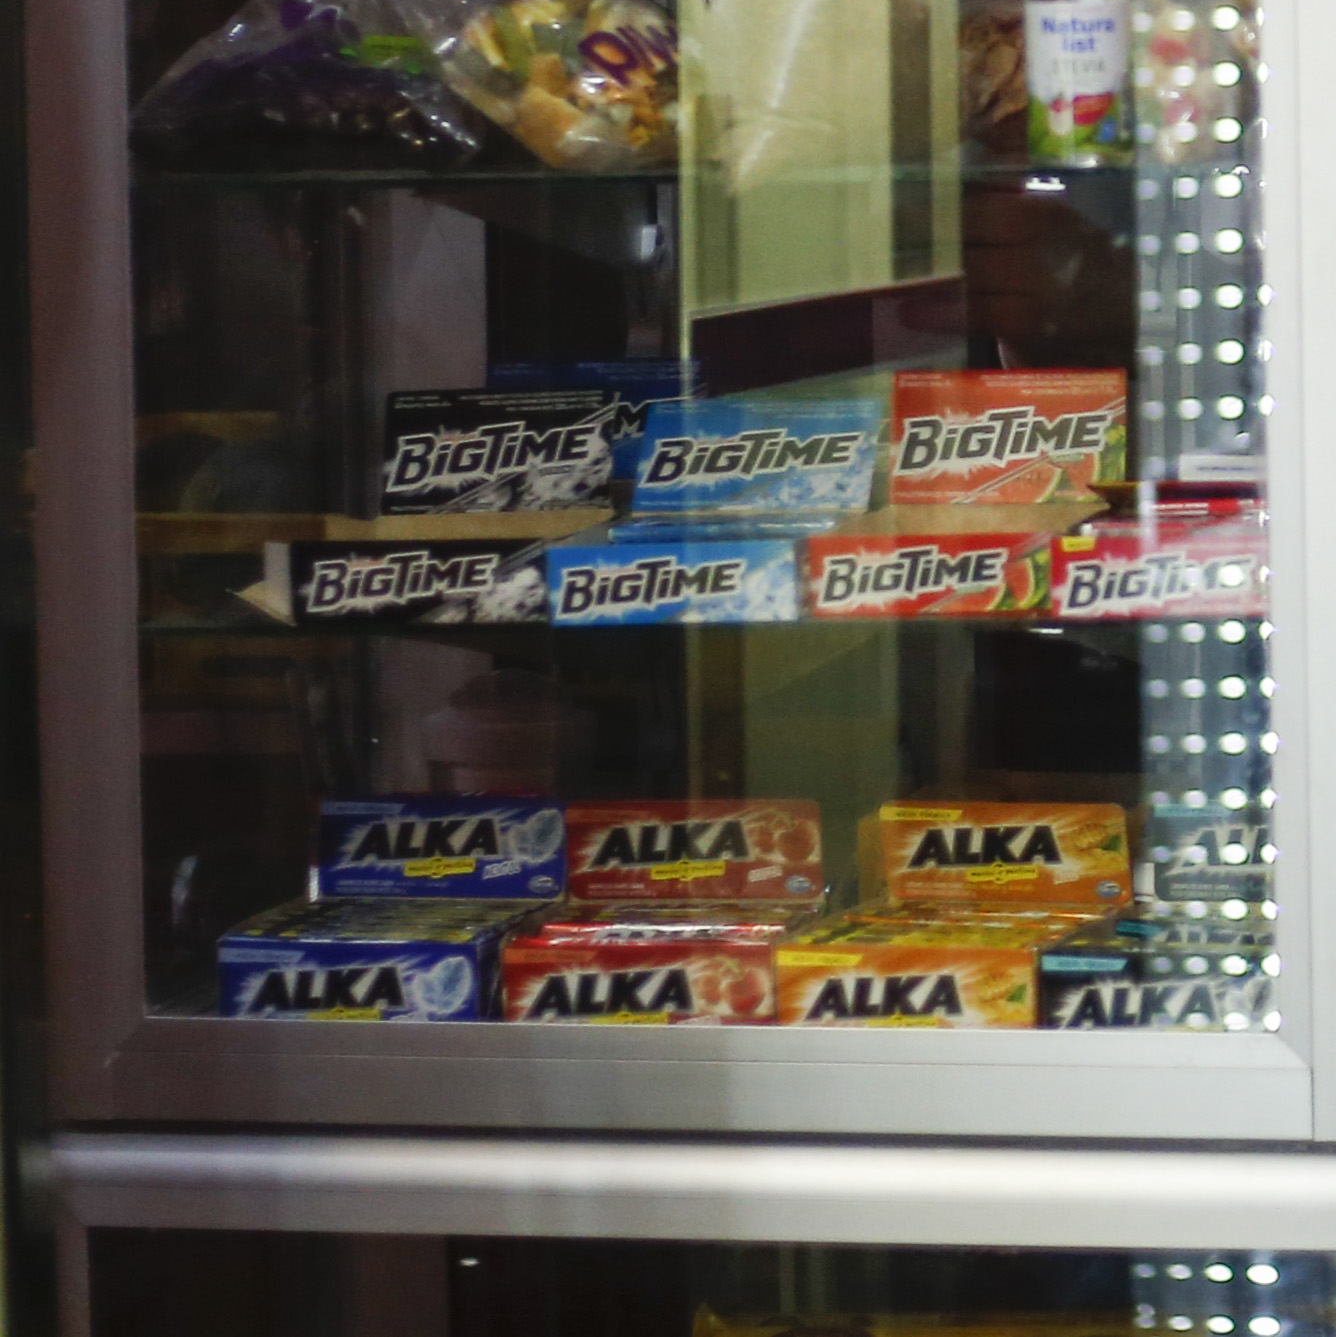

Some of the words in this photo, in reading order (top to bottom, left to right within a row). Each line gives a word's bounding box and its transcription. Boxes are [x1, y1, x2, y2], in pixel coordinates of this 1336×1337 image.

[352, 818, 499, 860] ALKA
[590, 820, 748, 868] ALKA
[907, 825, 1062, 868] ALKA
[248, 966, 405, 1015] ALKA
[529, 969, 695, 1017] ALKA
[805, 975, 963, 1020] ALKA
